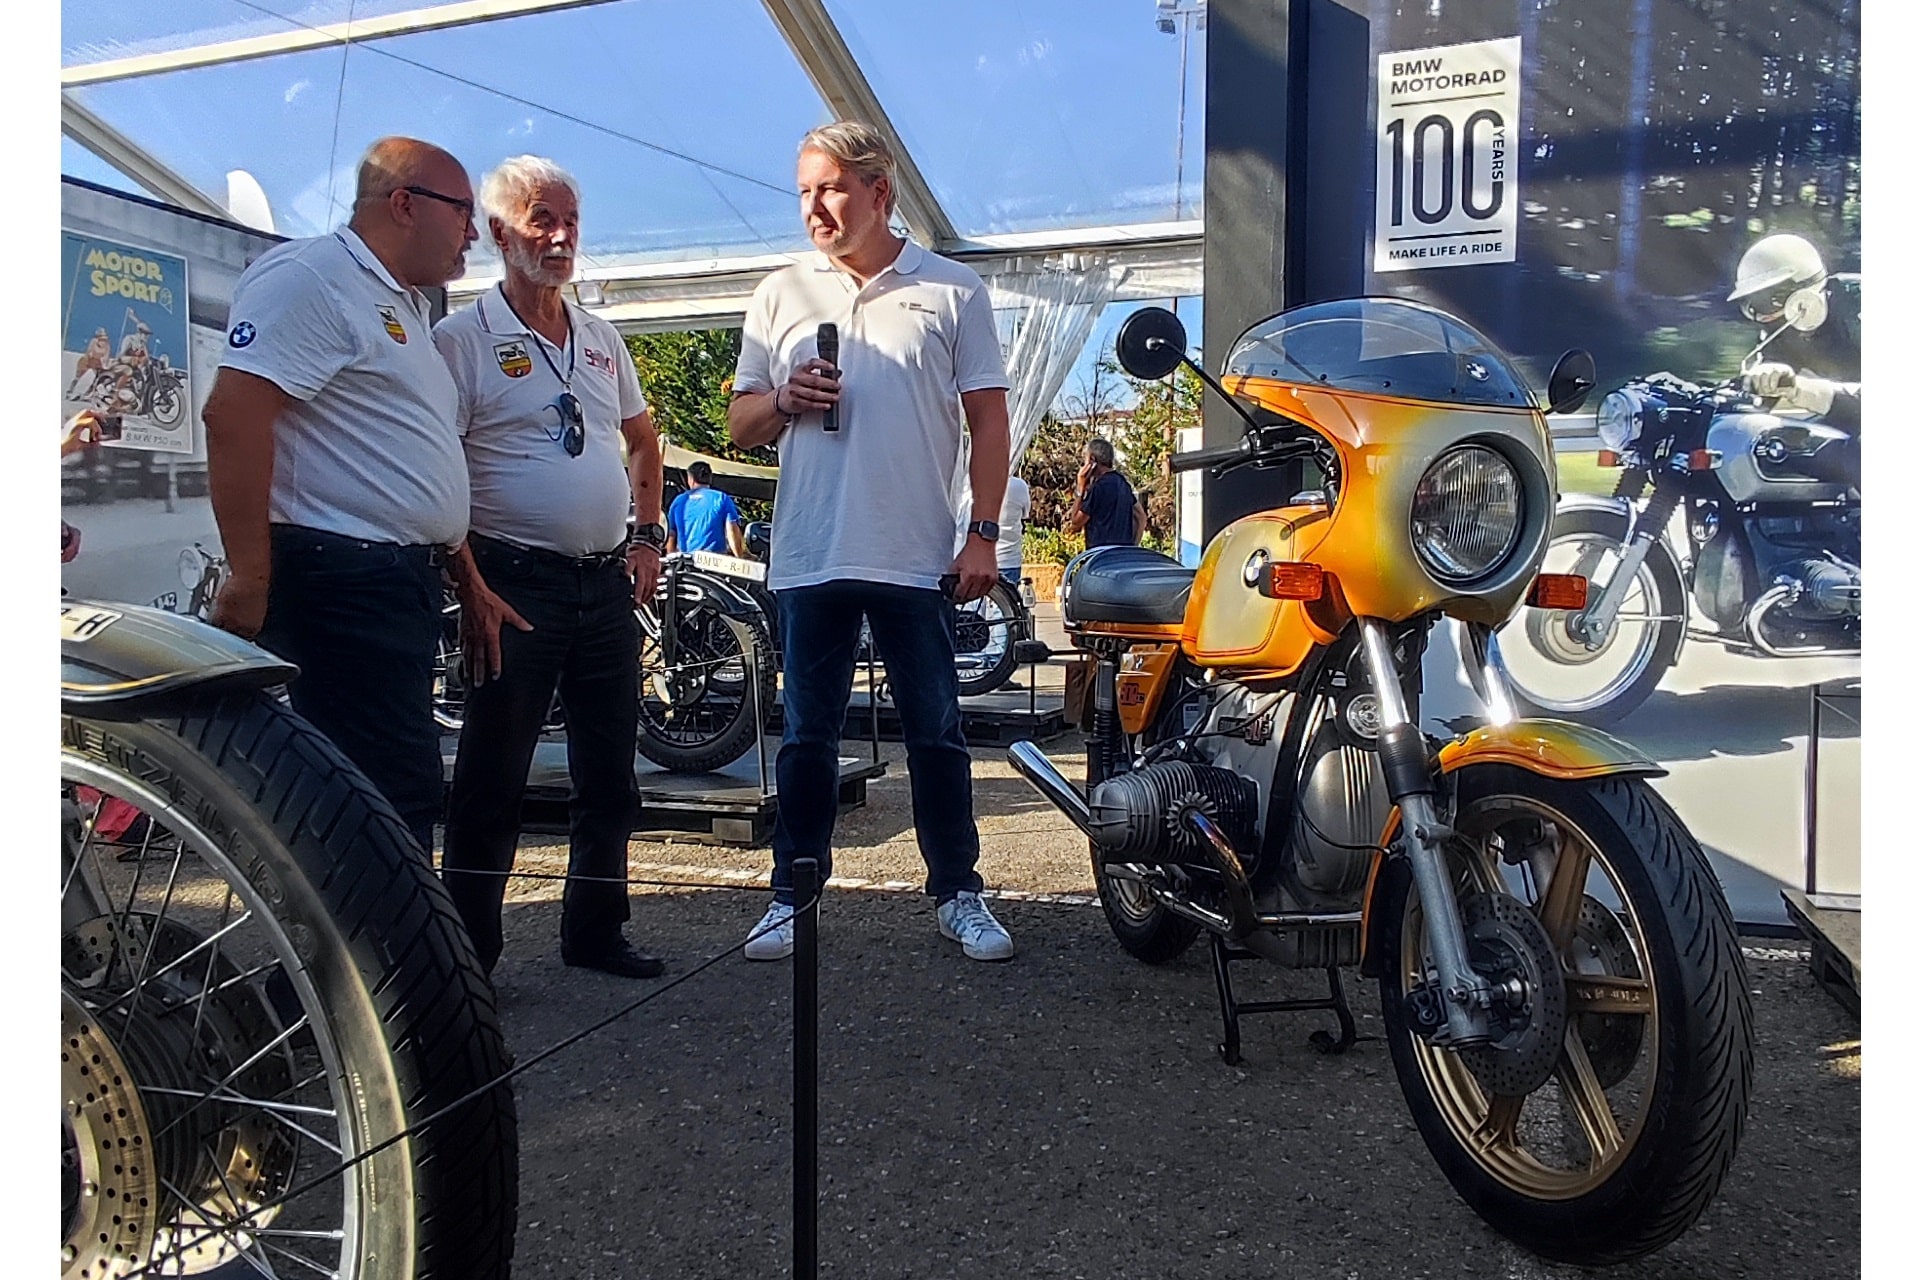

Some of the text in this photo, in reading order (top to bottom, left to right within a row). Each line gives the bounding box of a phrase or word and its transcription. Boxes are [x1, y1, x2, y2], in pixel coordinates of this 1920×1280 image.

[1390, 69, 1507, 95] MOTORRAD
[1392, 58, 1443, 77] BMW
[1386, 108, 1505, 227] 100
[1491, 126, 1505, 181] YEARS
[84, 247, 164, 282] MOTOR
[1388, 242, 1503, 261] MAKE LIFE A RIDE
[90, 269, 161, 304] SPORT
[696, 553, 722, 568] BMW
